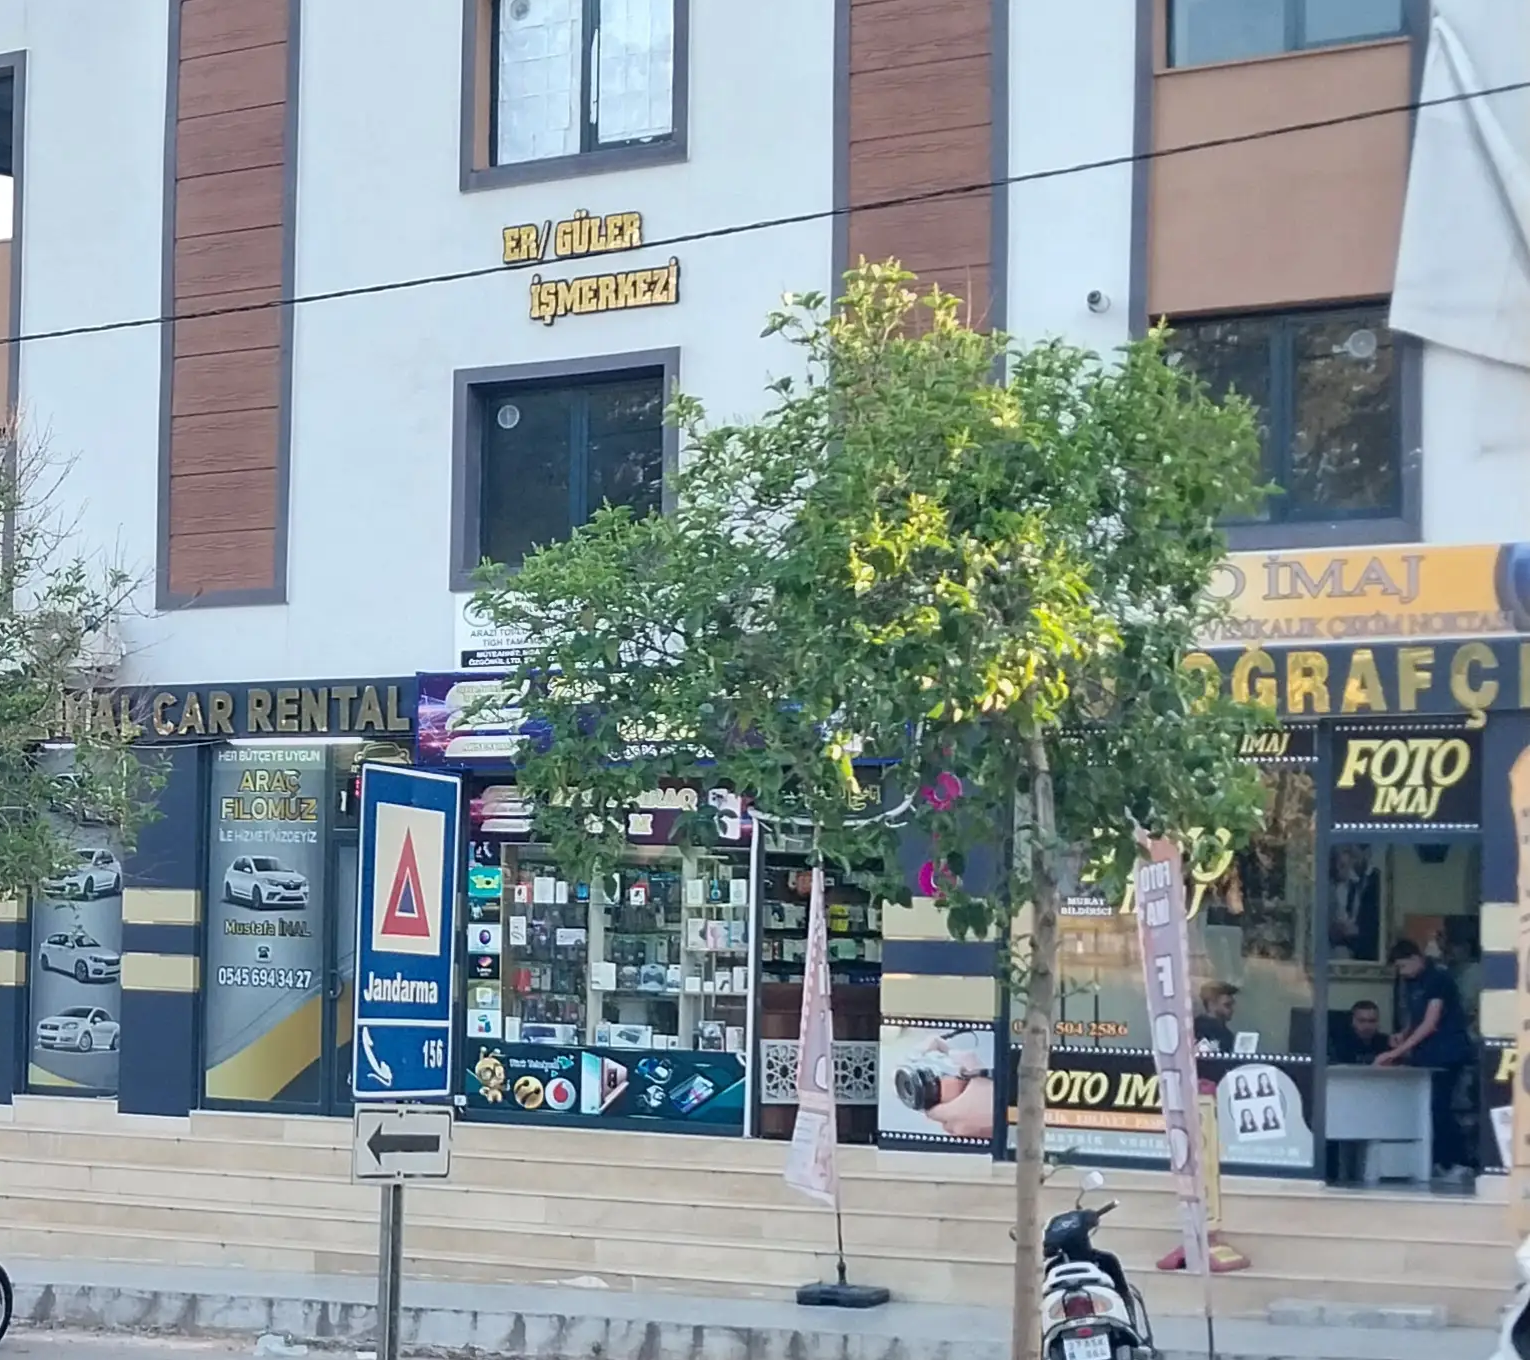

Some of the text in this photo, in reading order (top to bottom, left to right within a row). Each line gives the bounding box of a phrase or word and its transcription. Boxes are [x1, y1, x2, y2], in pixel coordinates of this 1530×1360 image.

[555, 209, 643, 257] GÜLER
[530, 256, 680, 326] İŞMERKEZİ
[1262, 554, 1426, 605] İMAJ
[152, 691, 236, 736] CAR
[246, 685, 410, 733] RENTAL
[218, 747, 321, 763] HER BÜTÇEYE UYGUN
[1336, 738, 1471, 789] FOTO
[238, 768, 302, 798] ARAÇ
[224, 919, 276, 937] Mustafa
[218, 966, 313, 989] 0545 694 34 27
[363, 971, 439, 1005] Jandarma
[1056, 1020, 1084, 1036] 504
[422, 1038, 444, 1069] 156
[1044, 1069, 1164, 1108] OTO IM
